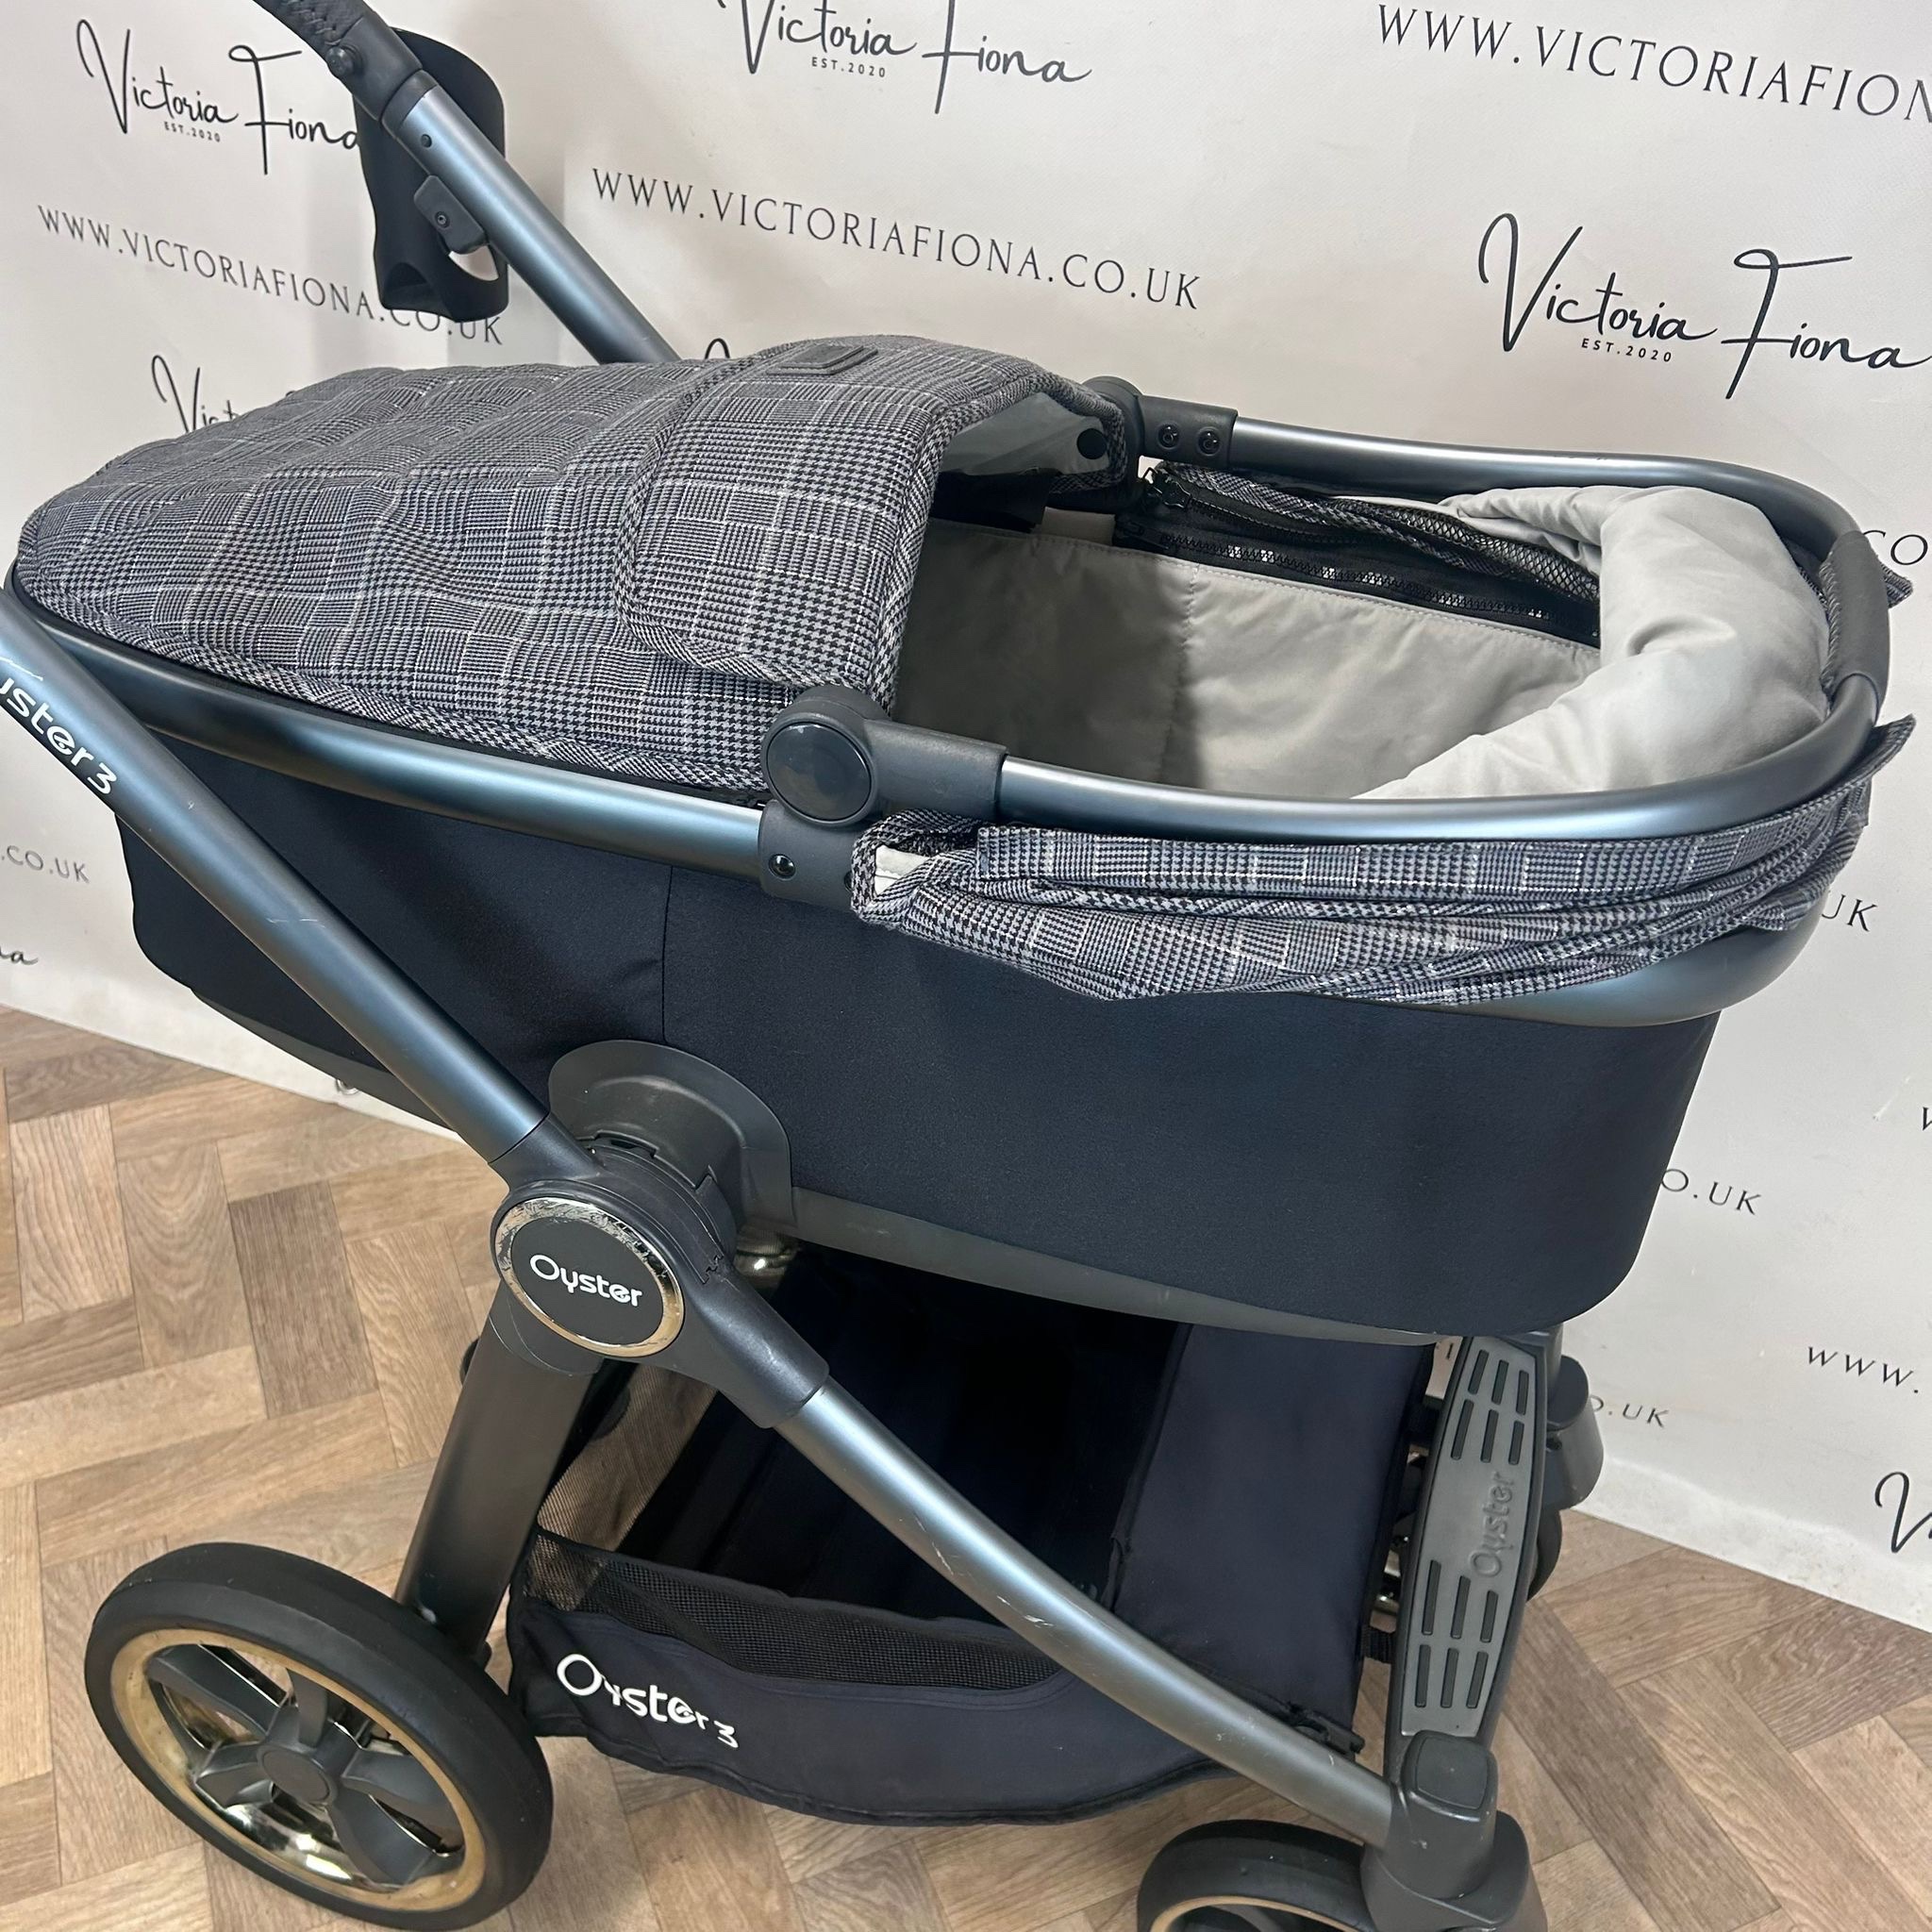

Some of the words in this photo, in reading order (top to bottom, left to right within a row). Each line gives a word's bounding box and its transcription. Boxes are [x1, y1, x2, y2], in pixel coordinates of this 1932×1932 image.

[76, 19, 239, 134] Victoria
[228, 45, 358, 175] Fiona
[717, 0, 918, 75] Victoria
[922, 0, 1093, 114] Fiona
[810, 56, 887, 78] EST.2020
[163, 121, 222, 142] EST.2020
[591, 167, 1200, 310] WWW.VICTORIAFIONA.CO.UK
[1478, 213, 1718, 353] Victoria
[1721, 249, 1932, 399] Fiona
[1581, 337, 1674, 363] EST.2020
[87, 762, 118, 794] 3
[529, 1254, 642, 1308] Oyster
[1470, 1471, 1514, 1577] Oyster
[557, 1654, 709, 1730] Oyster
[713, 1720, 739, 1748] 3
